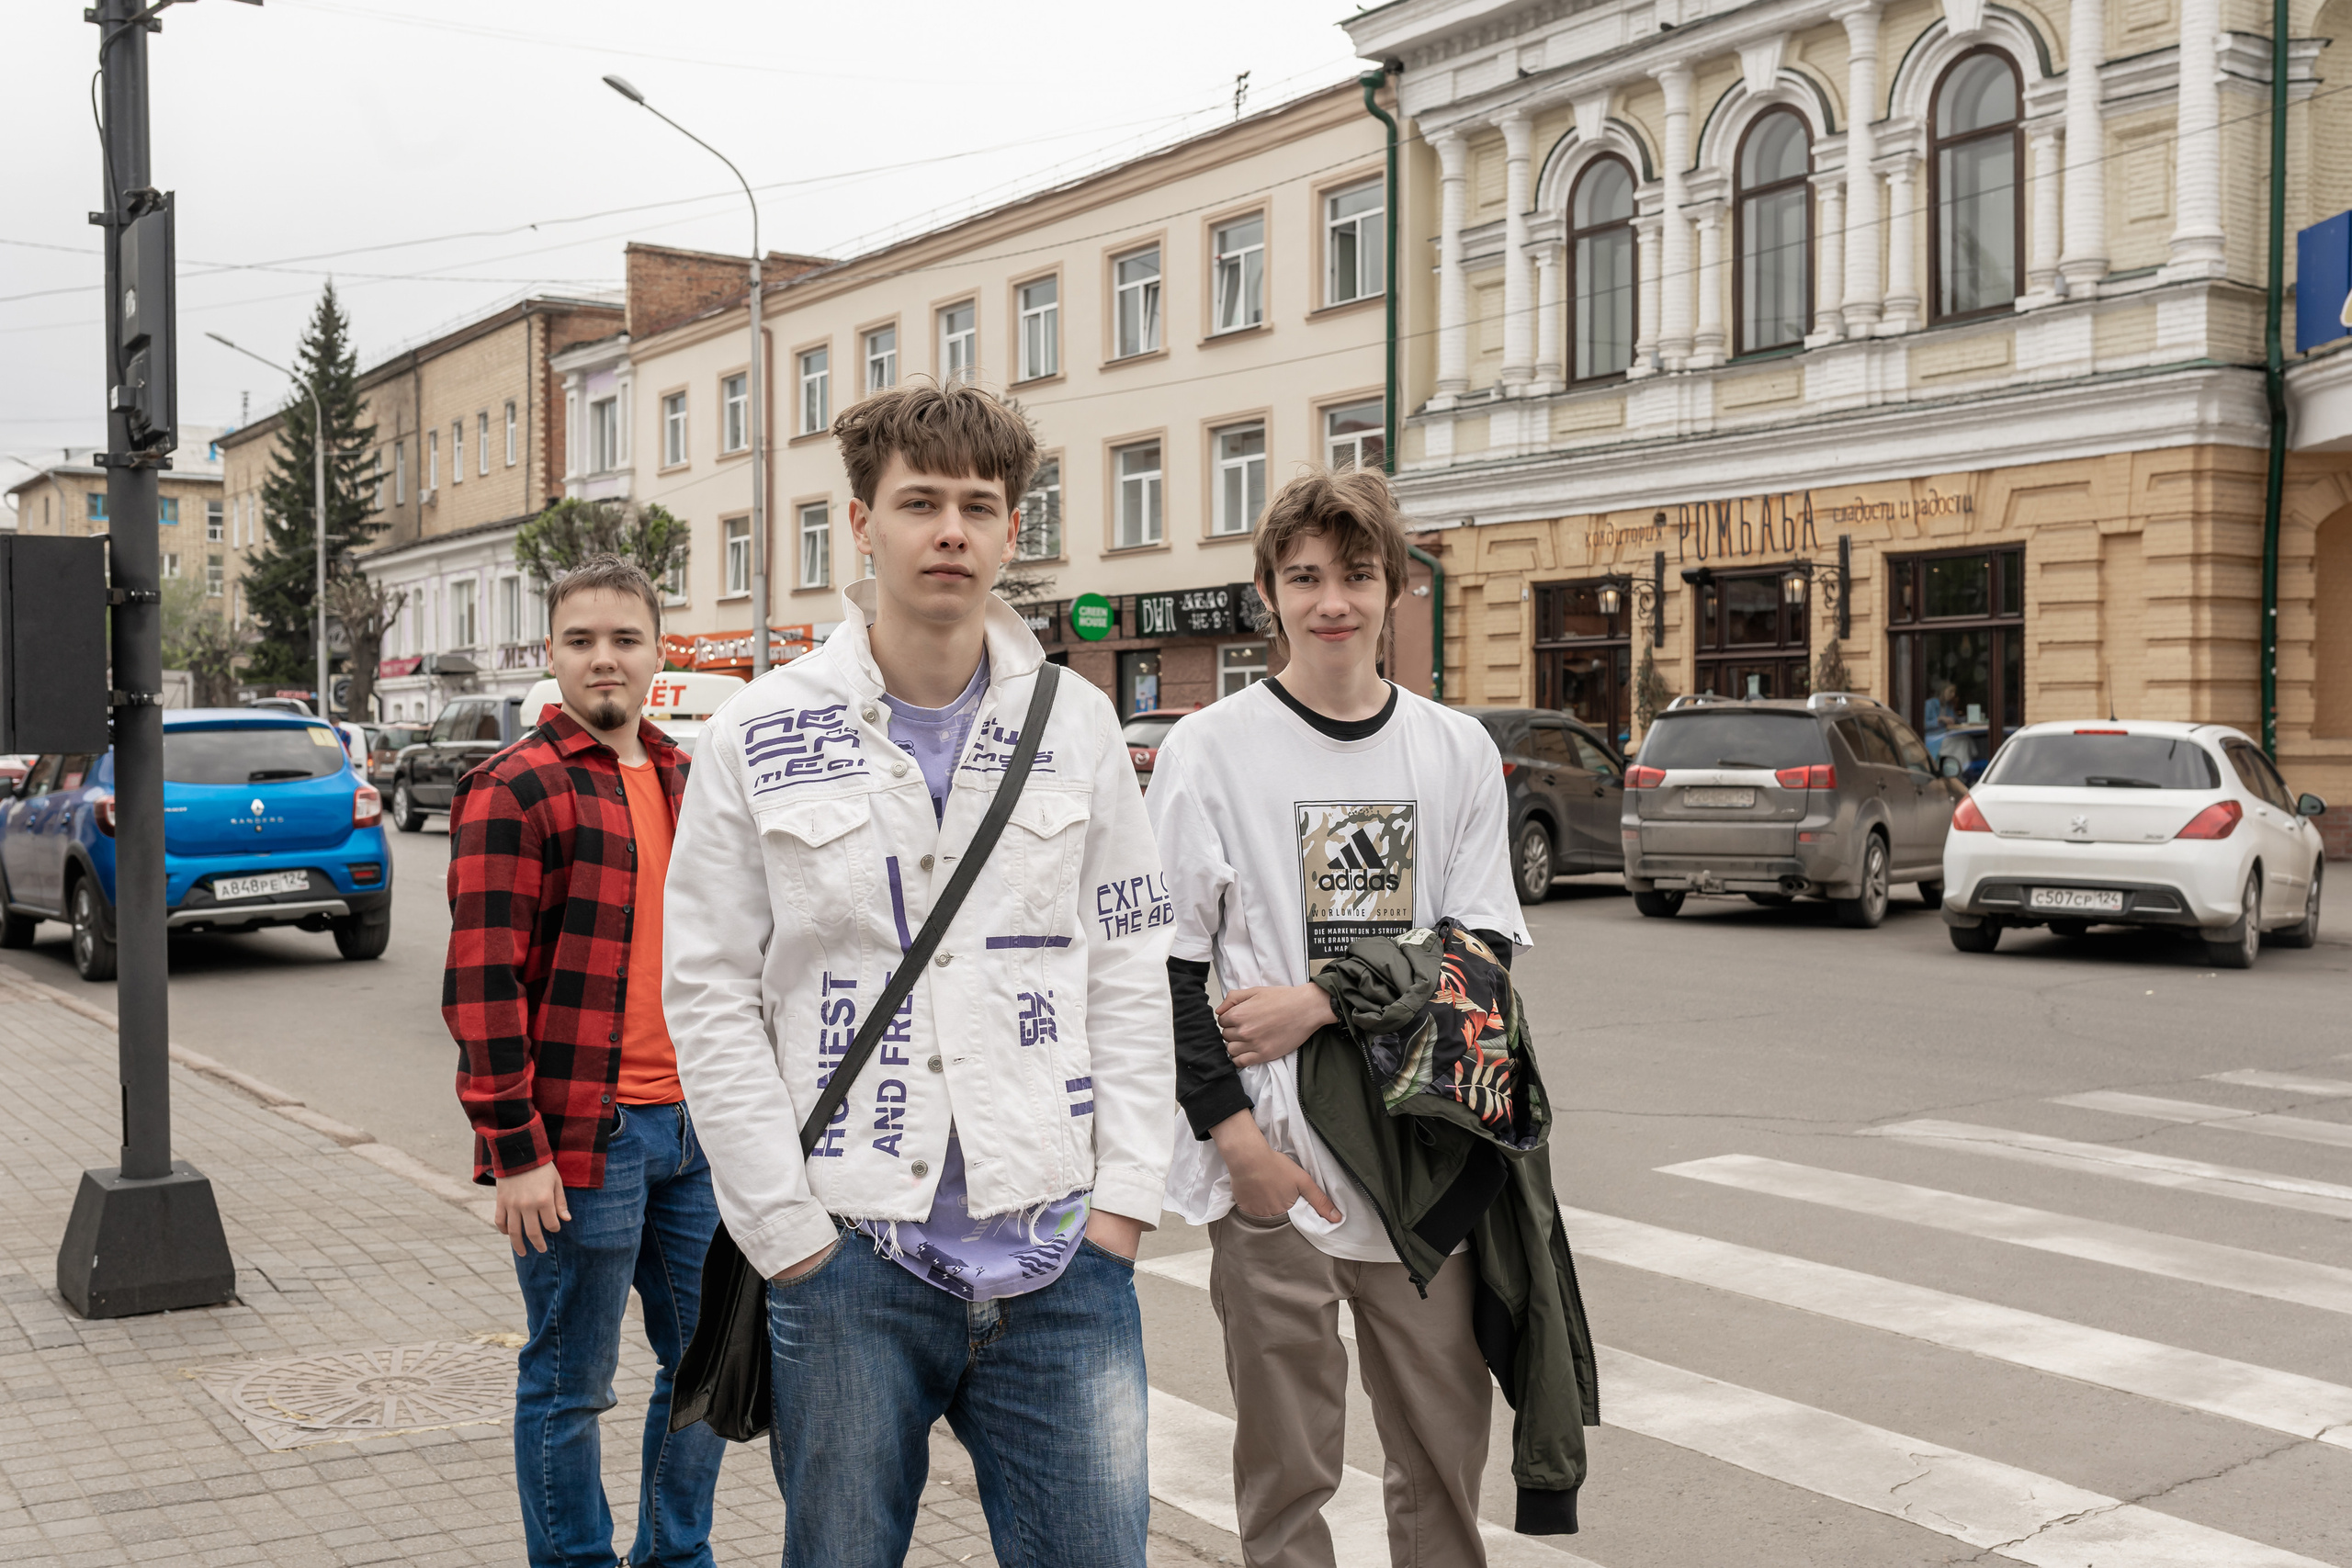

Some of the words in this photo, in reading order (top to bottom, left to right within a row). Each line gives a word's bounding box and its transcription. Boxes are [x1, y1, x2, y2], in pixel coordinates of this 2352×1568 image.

[1833, 496, 1894, 524] сладости
[1900, 500, 1909, 519] и
[1914, 488, 1974, 525] радости
[1679, 490, 1818, 562] РОМБАБА
[1079, 606, 1108, 616] GREEN
[1079, 616, 1108, 627] HOUSE
[1317, 869, 1399, 891] adidas
[2097, 892, 2119, 905] 124
[1312, 908, 1365, 918] WORLDWIDE
[1376, 908, 1407, 917] SPORT
[1099, 908, 1143, 941] THE
[873, 1078, 908, 1158] AND
